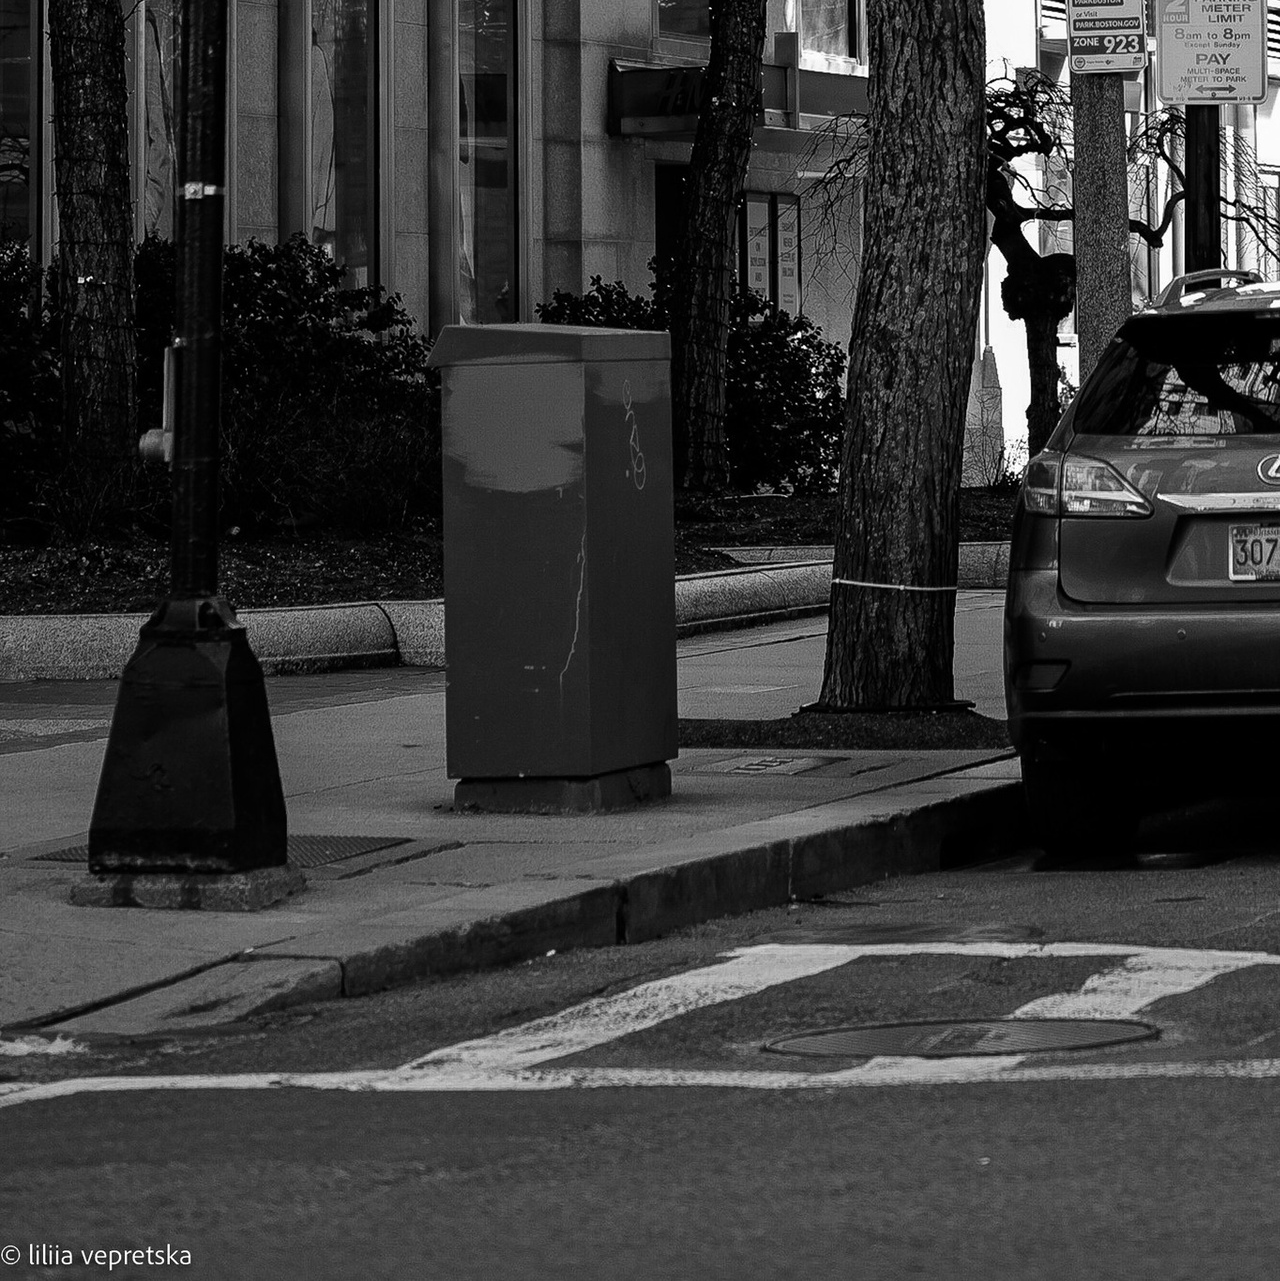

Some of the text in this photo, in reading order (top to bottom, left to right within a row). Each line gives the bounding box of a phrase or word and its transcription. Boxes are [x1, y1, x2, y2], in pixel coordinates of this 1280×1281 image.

[1201, 4, 1252, 13] METER
[1163, 14, 1188, 22] HOUR
[1208, 14, 1245, 23] LIMIT
[1075, 20, 1140, 29] PARK.BOSTON.GOV
[1175, 28, 1202, 40] 8am
[1223, 28, 1251, 41] 8pm
[1073, 35, 1139, 53] ZONE 923
[1213, 41, 1241, 49] Sunday
[1195, 53, 1231, 65] PAY
[1186, 67, 1240, 75] MULTI-SPACE
